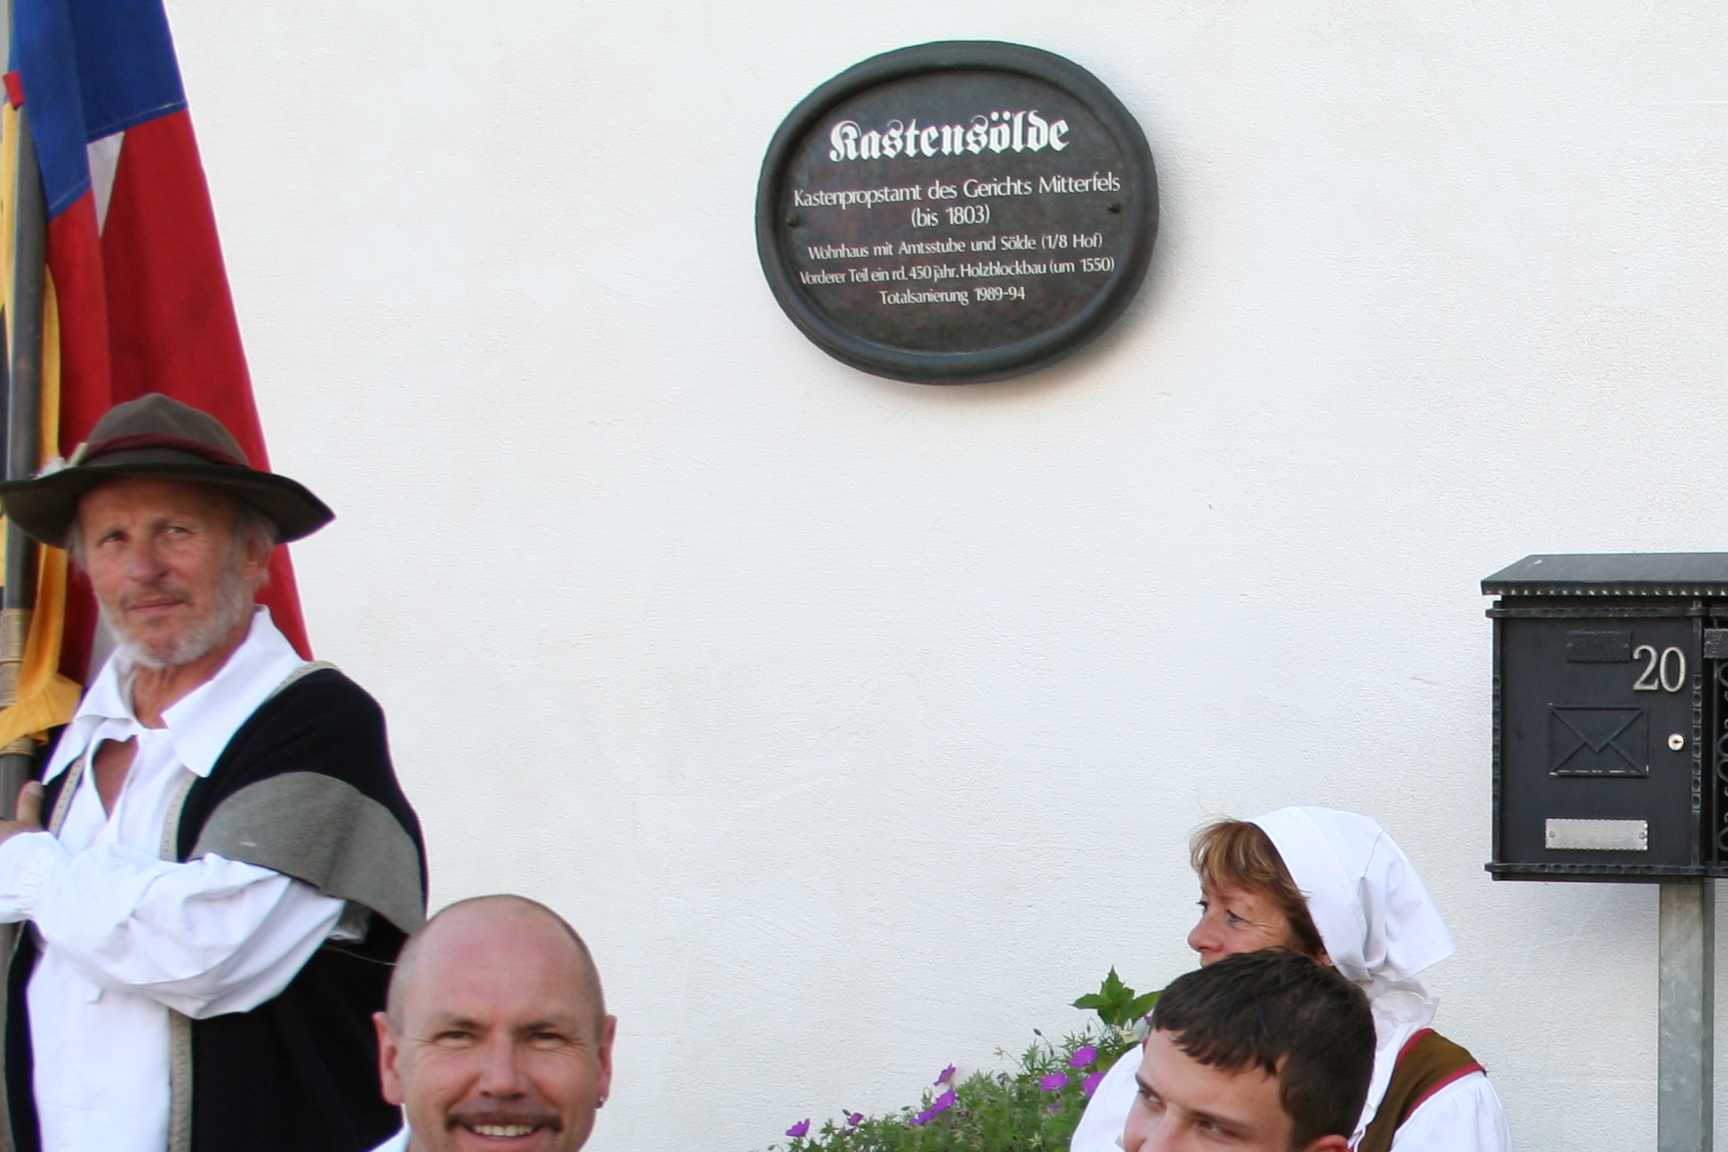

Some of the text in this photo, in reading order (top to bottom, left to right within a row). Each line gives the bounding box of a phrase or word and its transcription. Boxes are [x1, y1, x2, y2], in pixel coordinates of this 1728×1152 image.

[829, 110, 1070, 162] Kastensölde
[794, 171, 1121, 210] Kastenpropstamt des Gerichts Mitterfels
[911, 203, 990, 228] (bis 1803)
[808, 232, 1103, 260] Wohnhaus mit Amtsstube und Sölde (1/8 Hof)
[800, 270, 846, 285] Vorderer
[848, 267, 869, 282] Teil
[871, 267, 889, 282] ein
[892, 266, 908, 281] rd.
[909, 265, 932, 280] 450
[961, 261, 1047, 278] Holzblockbau
[1049, 259, 1075, 274] (um
[1080, 256, 1115, 273] 1550)
[880, 286, 1026, 306] Totalsanierung 1989-94
[1633, 644, 1686, 692] 20
